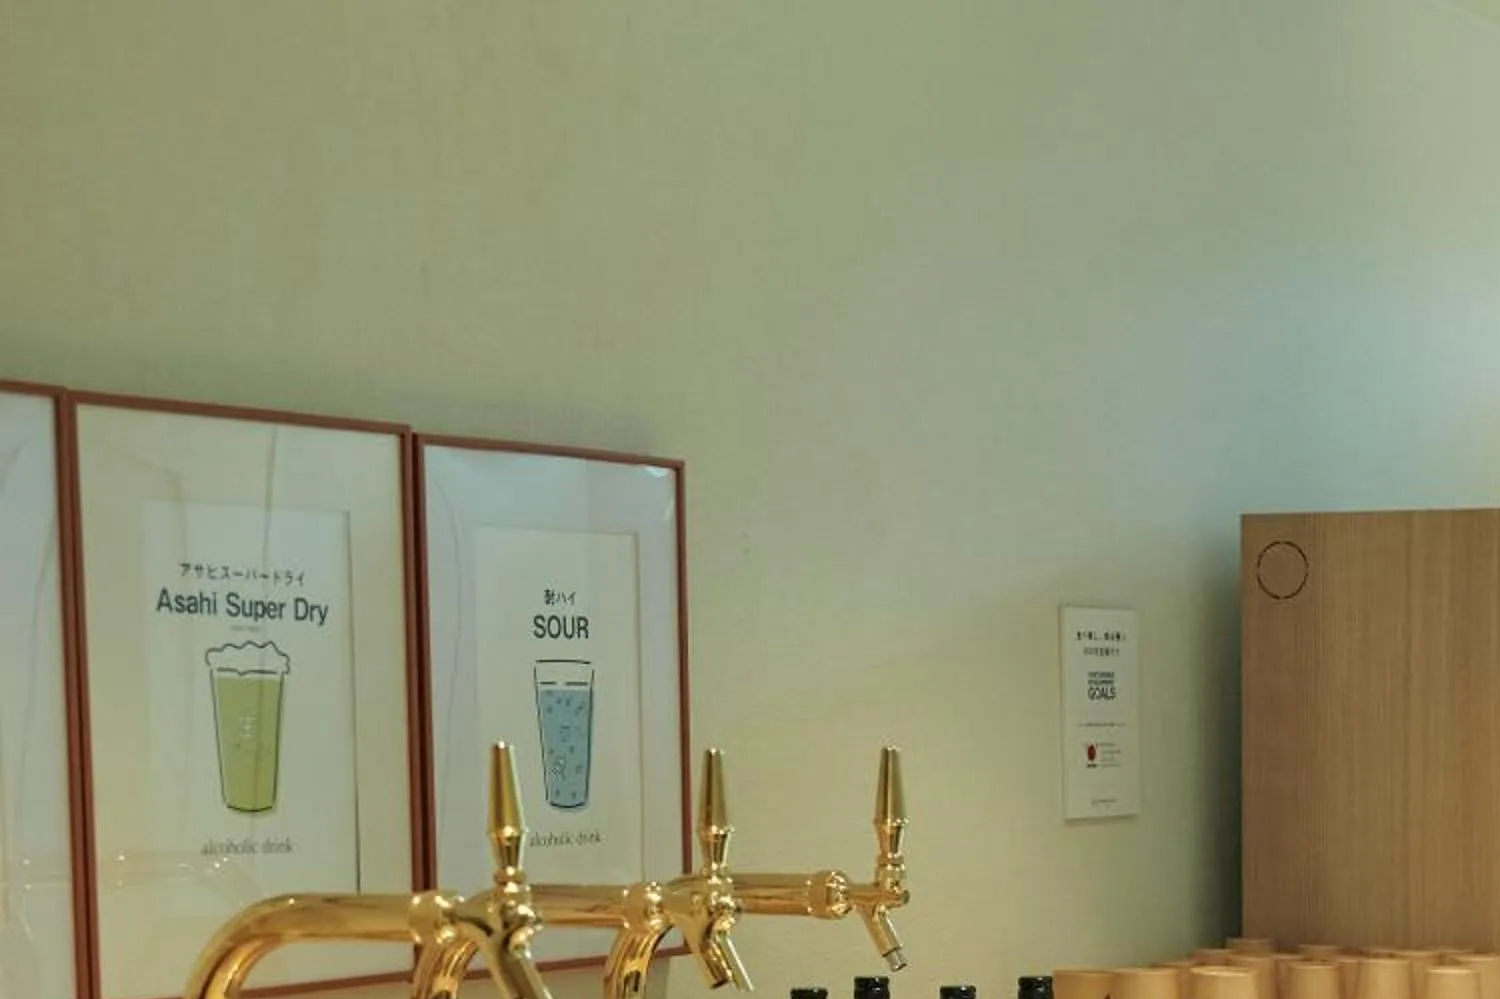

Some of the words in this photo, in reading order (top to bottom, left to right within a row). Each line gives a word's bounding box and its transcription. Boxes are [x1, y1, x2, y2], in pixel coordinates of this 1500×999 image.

[156, 585, 217, 616] Asahi
[225, 592, 287, 622] Super
[294, 597, 329, 626] Dry
[533, 614, 589, 640] SOUR
